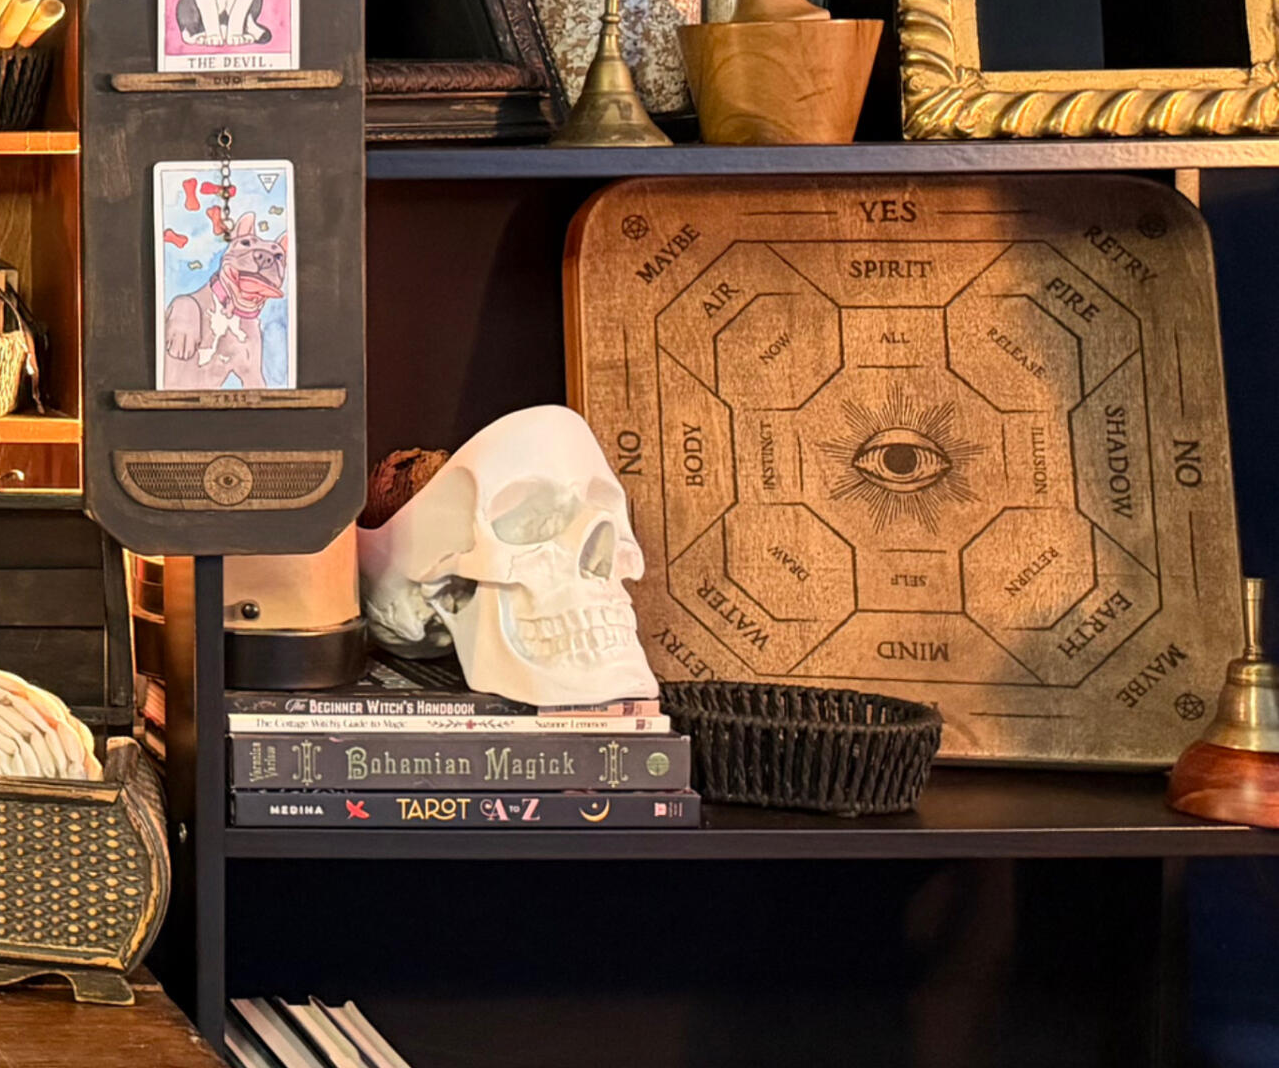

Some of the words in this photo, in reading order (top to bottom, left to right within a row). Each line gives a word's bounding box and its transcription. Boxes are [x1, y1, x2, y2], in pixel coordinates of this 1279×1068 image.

[188, 57, 215, 69] THE
[859, 200, 917, 223] YES
[635, 223, 701, 285] MAYBE
[849, 260, 932, 279] SPIRIT
[1082, 224, 1159, 285] RETRY
[700, 281, 741, 319] AIR
[1045, 276, 1101, 324] FIRE
[758, 332, 792, 366] NOW
[879, 332, 911, 344] ALL
[986, 326, 1047, 380] RELEASE
[616, 430, 643, 476] NO
[682, 422, 704, 487] BODY
[759, 419, 776, 491] INSTINCT
[1030, 426, 1049, 495] ILLUSION
[1105, 405, 1133, 520] SHADOW
[1173, 439, 1203, 489] NO
[767, 545, 810, 582] DRAW
[1004, 546, 1060, 597] RETURN
[695, 578, 770, 651] WATER
[1056, 589, 1132, 659] EARTH
[652, 627, 714, 680] ETRY
[876, 640, 950, 662] MIND
[1116, 642, 1188, 709] MAYBE
[285, 699, 308, 712] The
[309, 699, 363, 714] BEGINNER
[366, 699, 414, 714] WITCH'S
[417, 701, 475, 715] HANDBOOK
[345, 746, 472, 780] Bohemian
[484, 747, 575, 780] Magick
[270, 805, 324, 815] MEDINA
[396, 798, 471, 821] TAROT
[480, 798, 510, 821] A
[521, 798, 541, 821] Z
